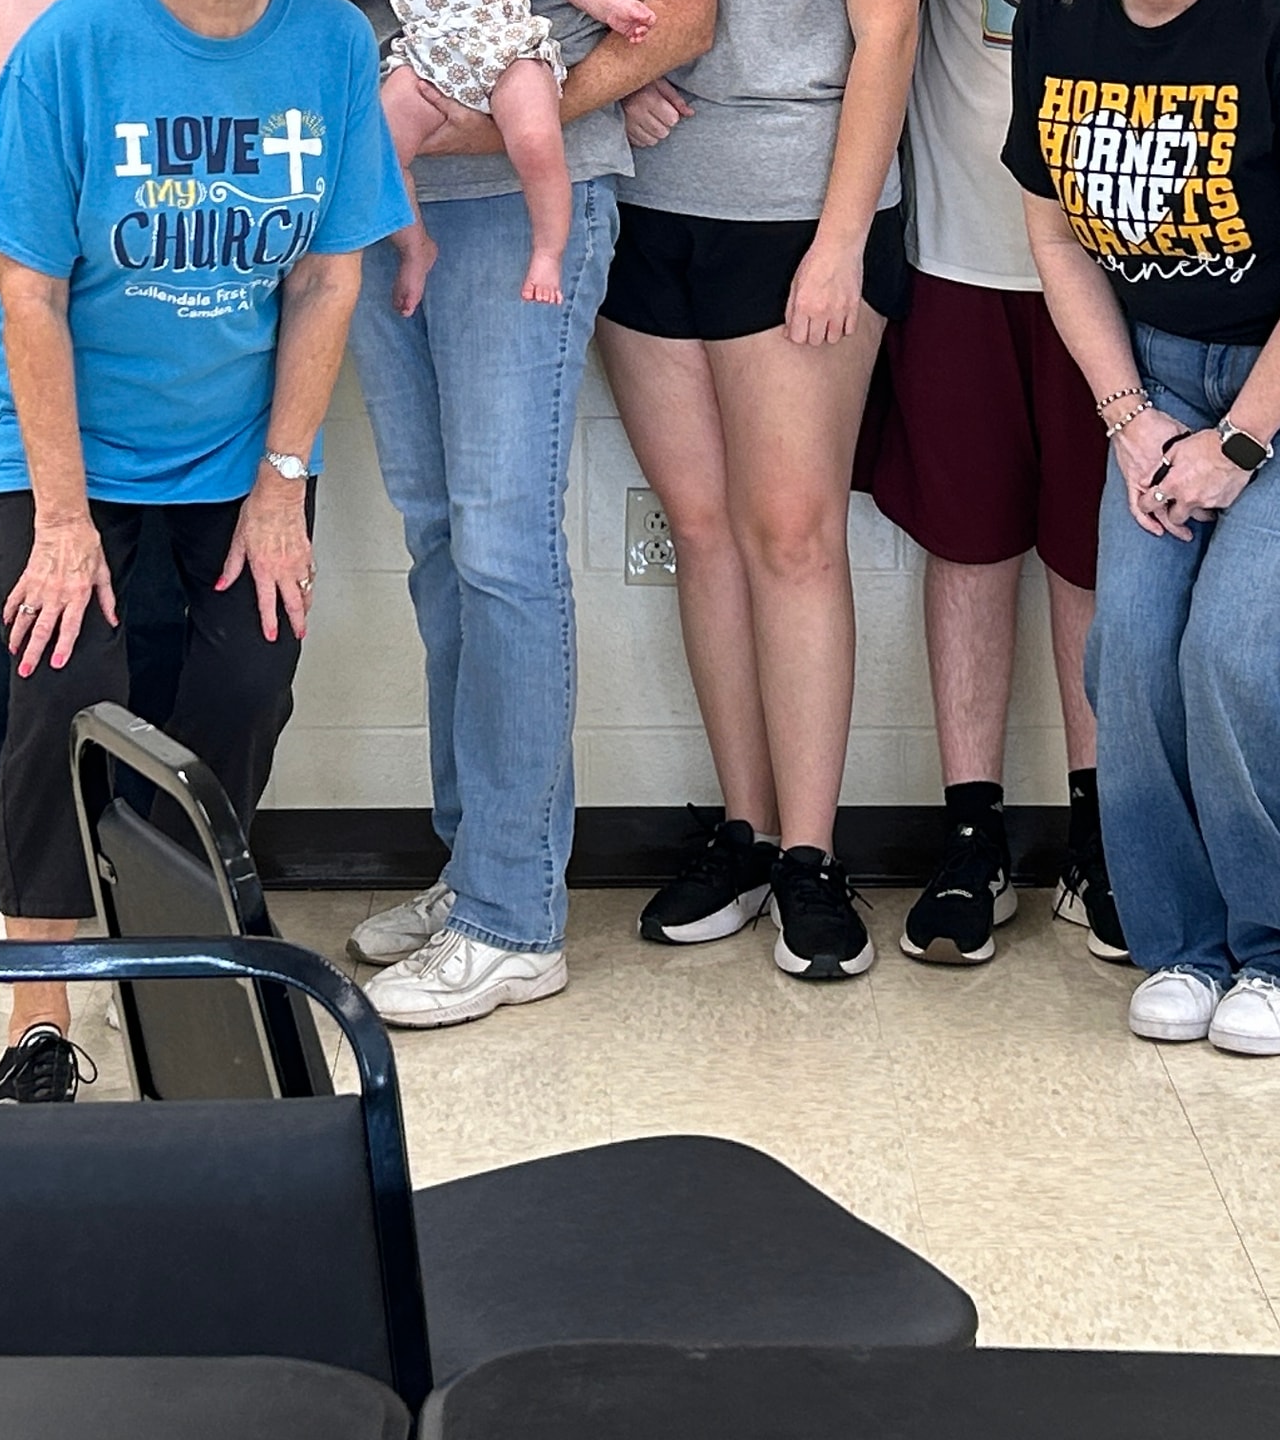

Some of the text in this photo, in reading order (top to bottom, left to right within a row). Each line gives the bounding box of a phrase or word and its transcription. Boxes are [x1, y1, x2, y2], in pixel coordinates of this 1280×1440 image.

[1038, 75, 1239, 131] HORNETS
[114, 115, 261, 178] I LOVE
[1038, 120, 1237, 176] HORNETS
[109, 203, 318, 273] CHURCH
[1069, 216, 1253, 257] ORNETS
[124, 285, 211, 307] Cullendale
[177, 305, 235, 319] Camden
